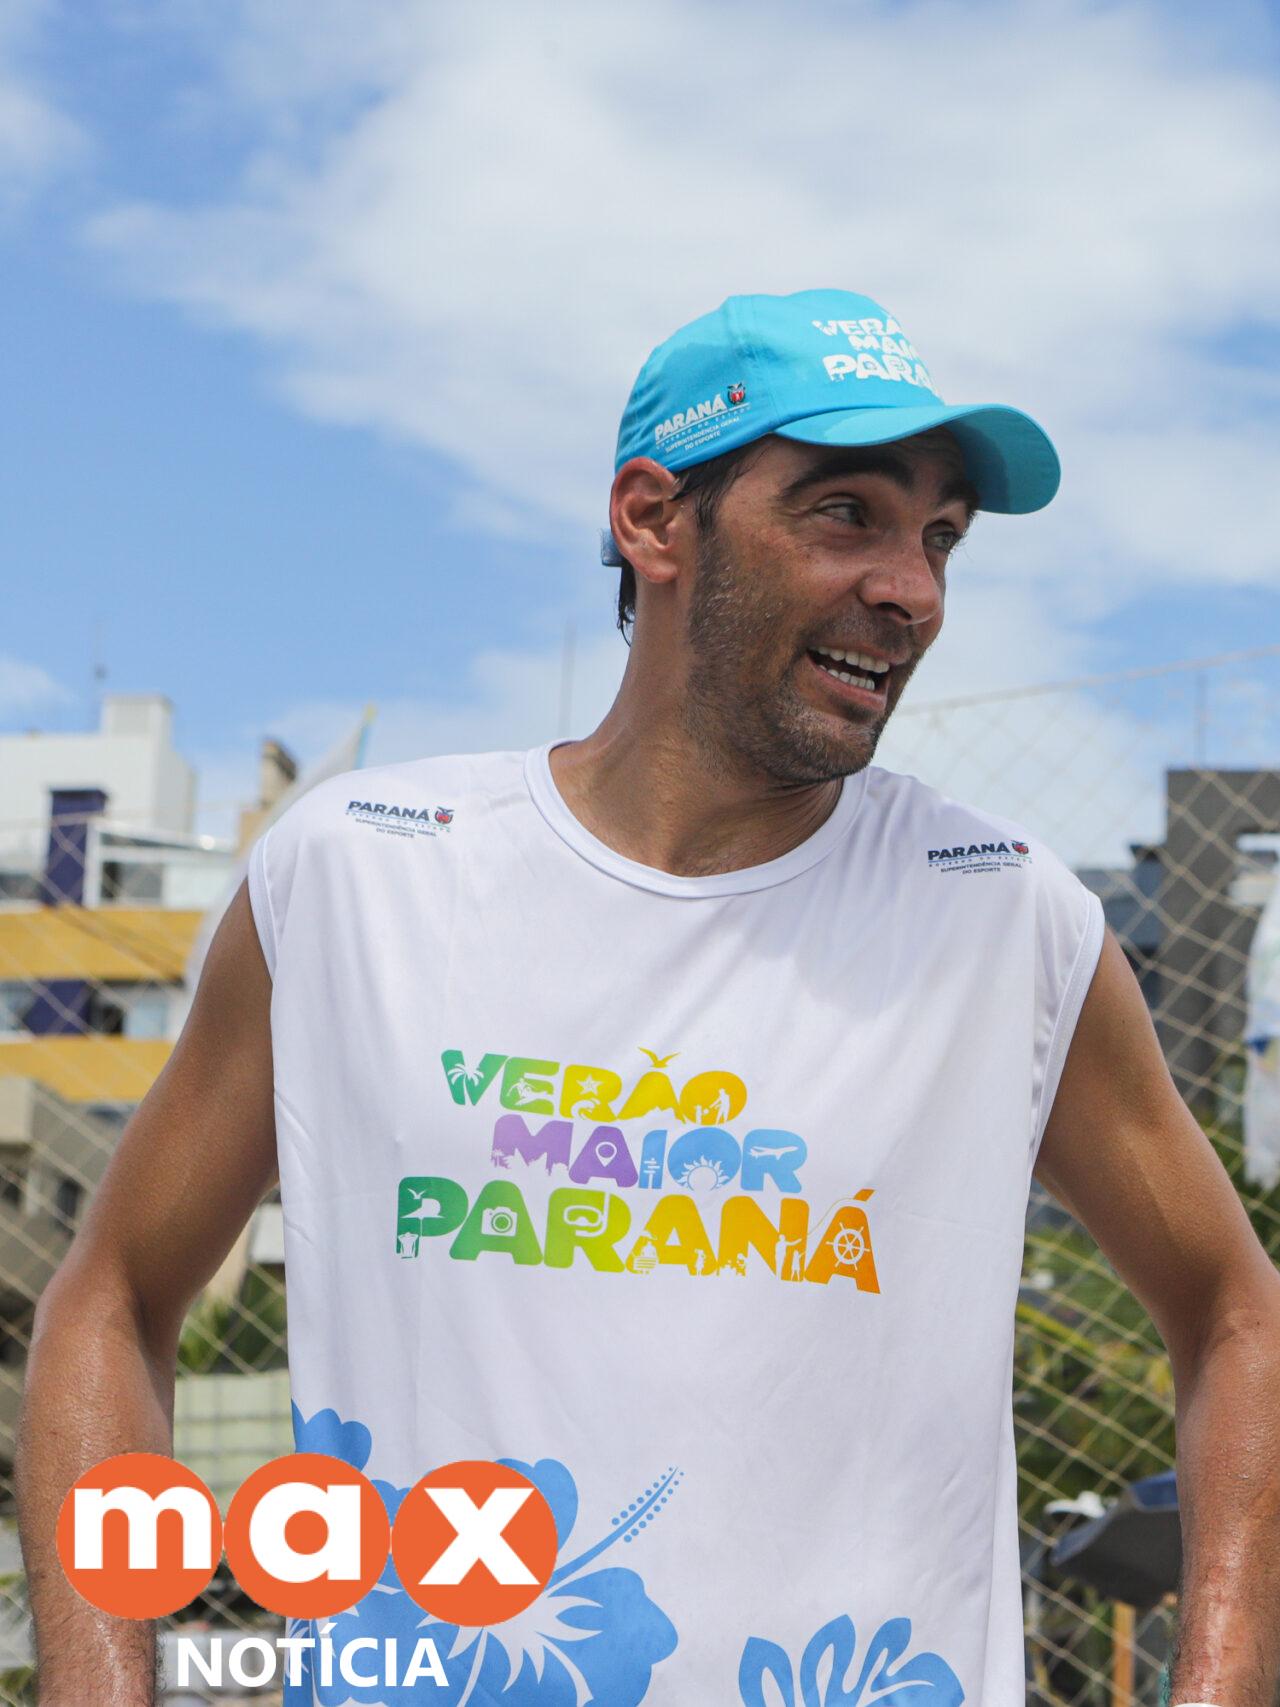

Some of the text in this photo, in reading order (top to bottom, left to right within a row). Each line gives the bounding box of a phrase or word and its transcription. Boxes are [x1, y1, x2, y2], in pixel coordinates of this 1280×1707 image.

[823, 353, 942, 400] PARA
[848, 335, 920, 361] MAI
[348, 801, 430, 821] PARANÁ
[441, 1047, 748, 1126] VERÃO
[490, 1114, 808, 1194] MAIOR
[396, 1176, 881, 1295] PARANÁ
